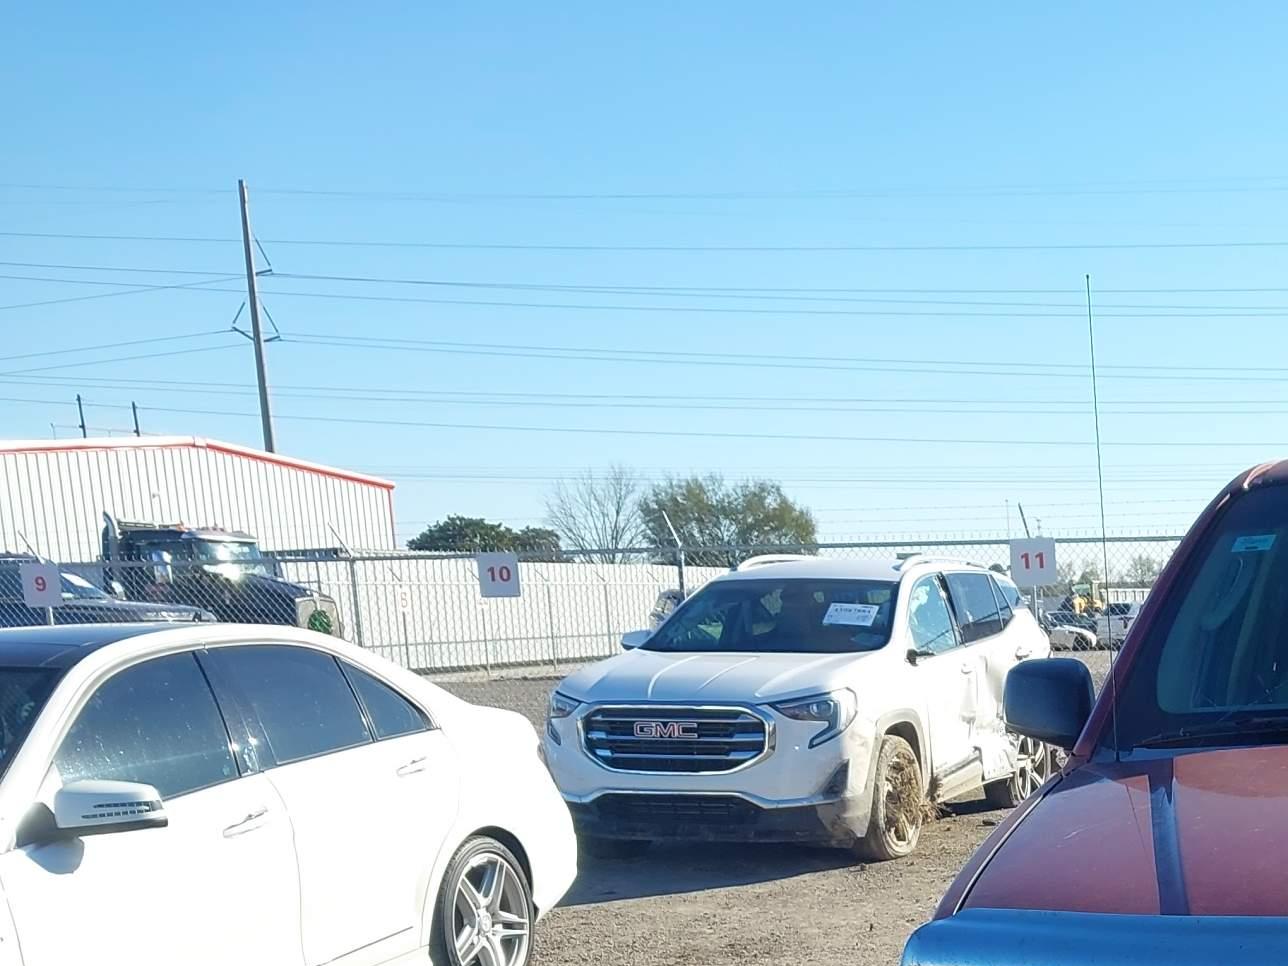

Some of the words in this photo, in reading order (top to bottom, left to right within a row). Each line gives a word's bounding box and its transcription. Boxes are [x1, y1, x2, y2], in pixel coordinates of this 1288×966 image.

[1020, 551, 1046, 570] 11
[487, 565, 512, 583] 10
[34, 576, 47, 592] 9
[633, 721, 698, 738] GMC
